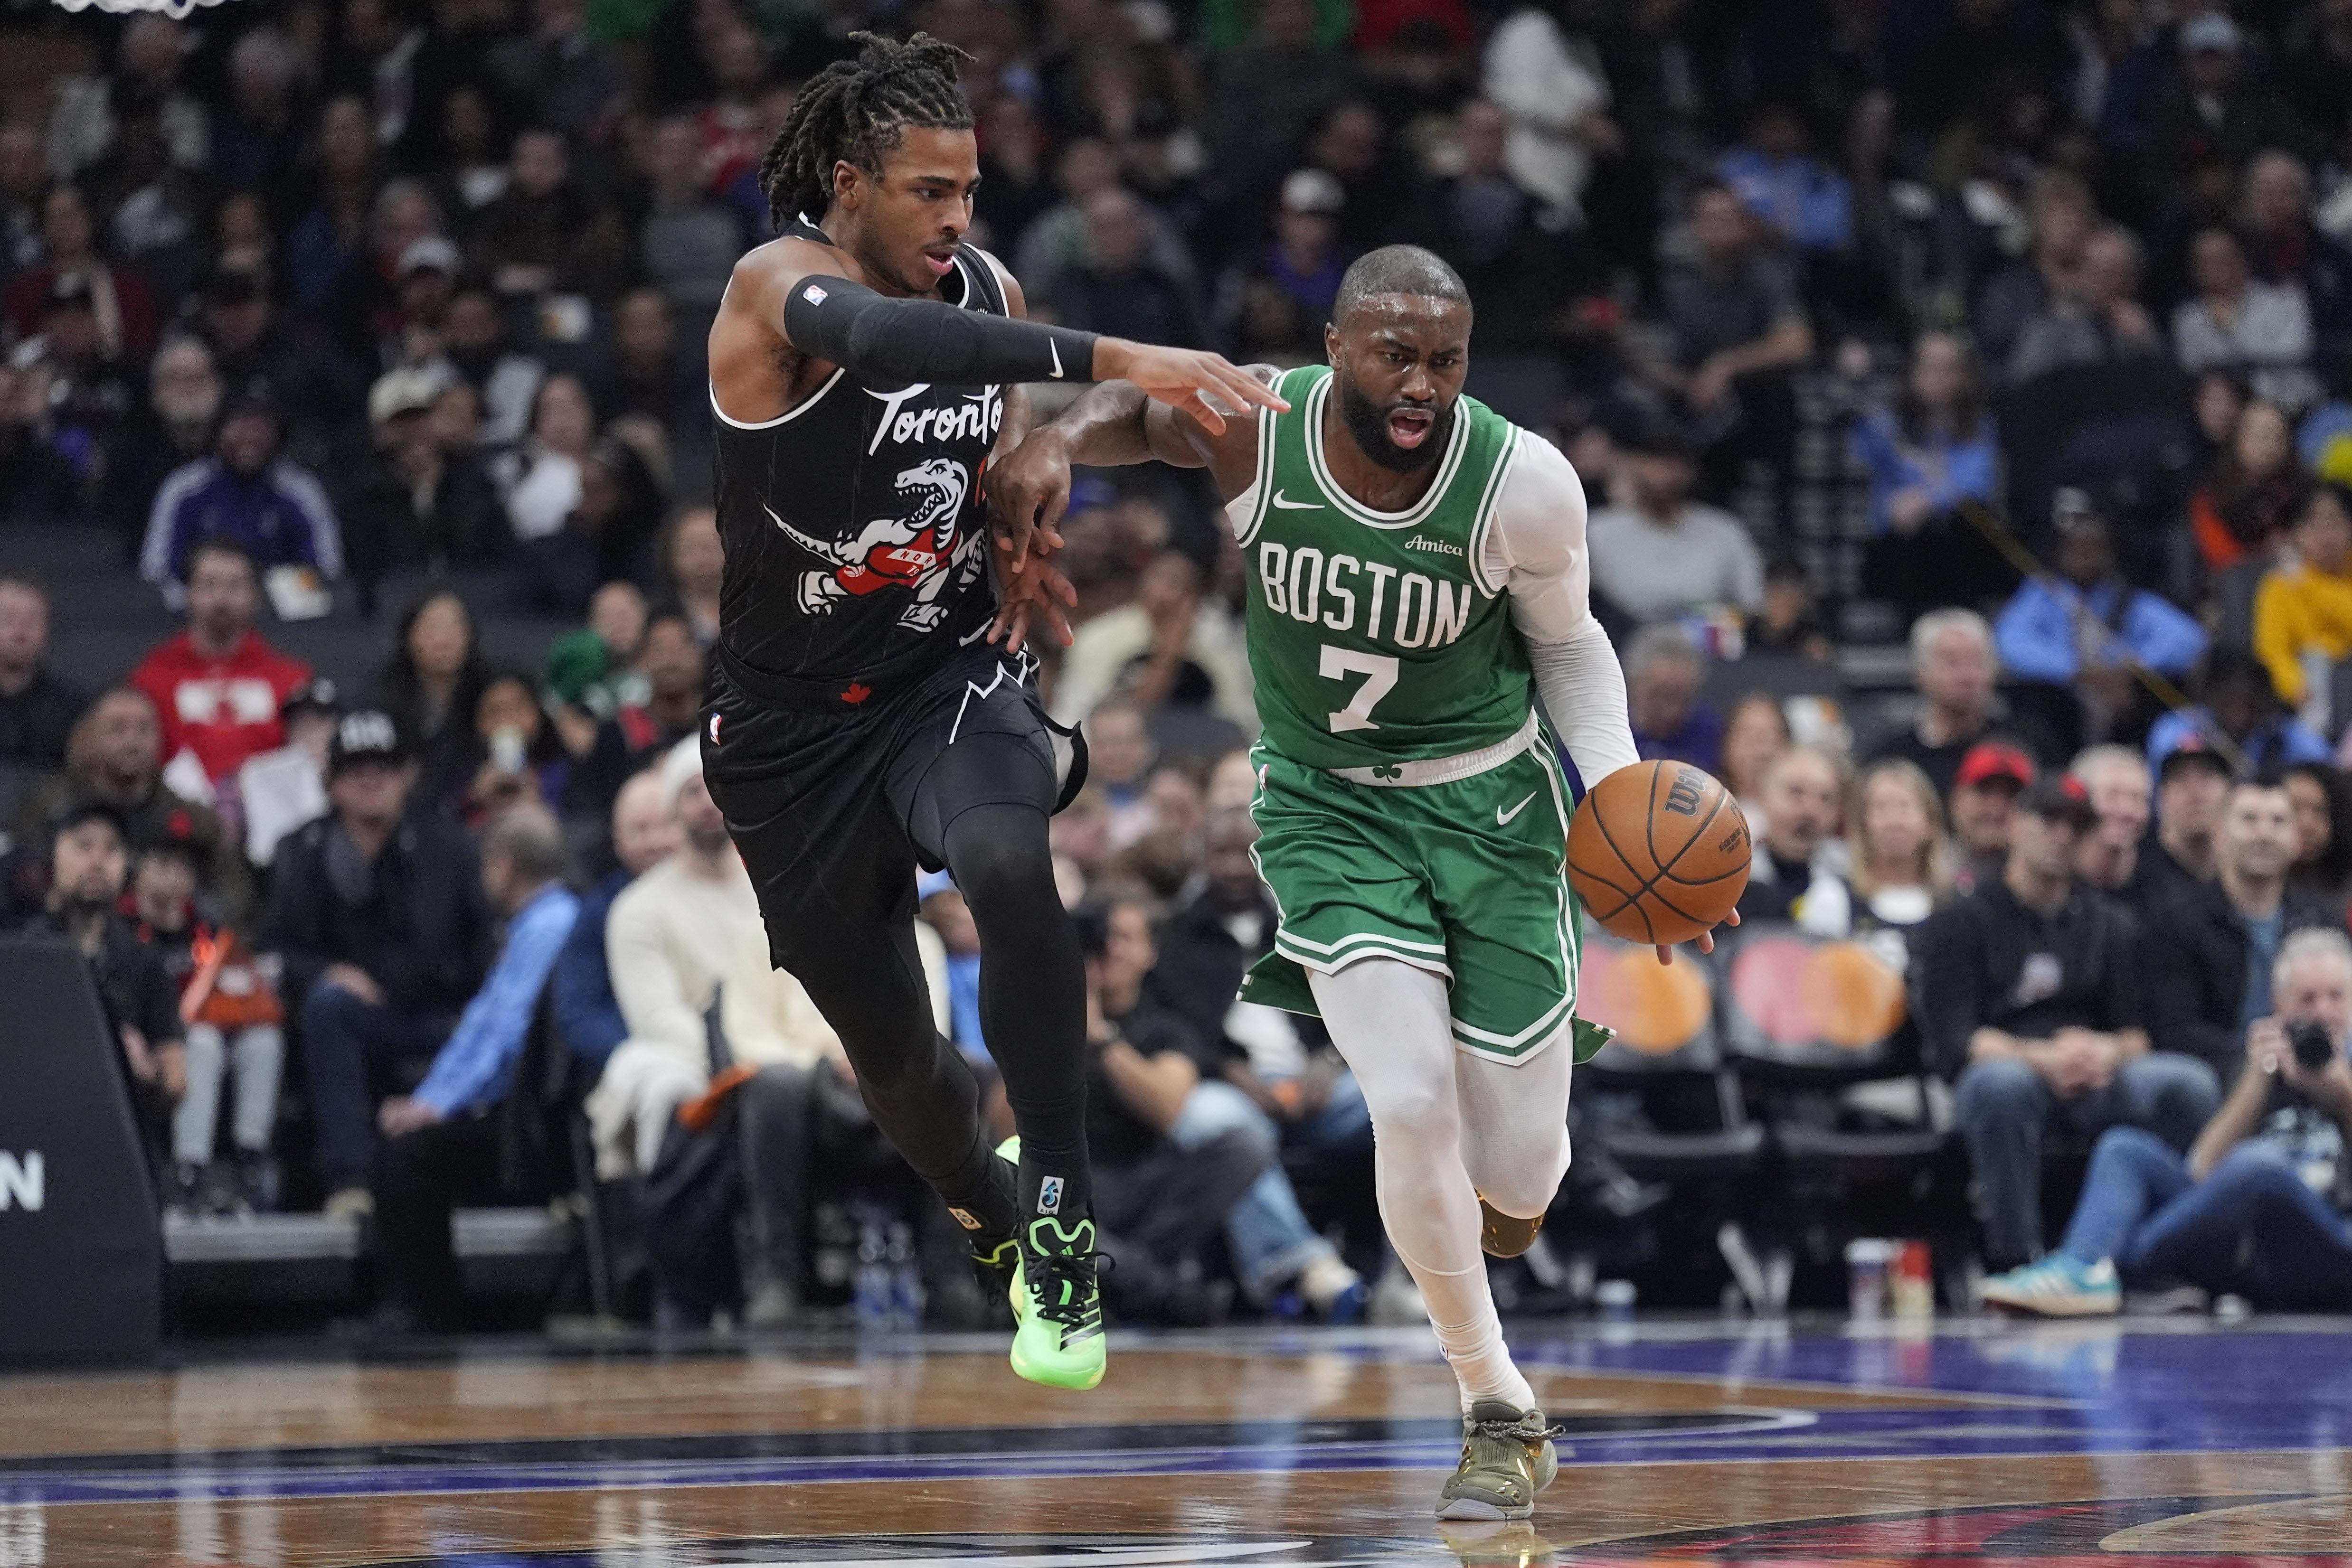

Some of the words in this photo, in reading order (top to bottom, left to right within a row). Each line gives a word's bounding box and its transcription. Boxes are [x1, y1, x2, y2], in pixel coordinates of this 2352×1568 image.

[861, 383, 1003, 456] Toronto
[1404, 535, 1463, 556] Amica
[1260, 542, 1472, 648] BOSTON
[1319, 644, 1399, 733] 7
